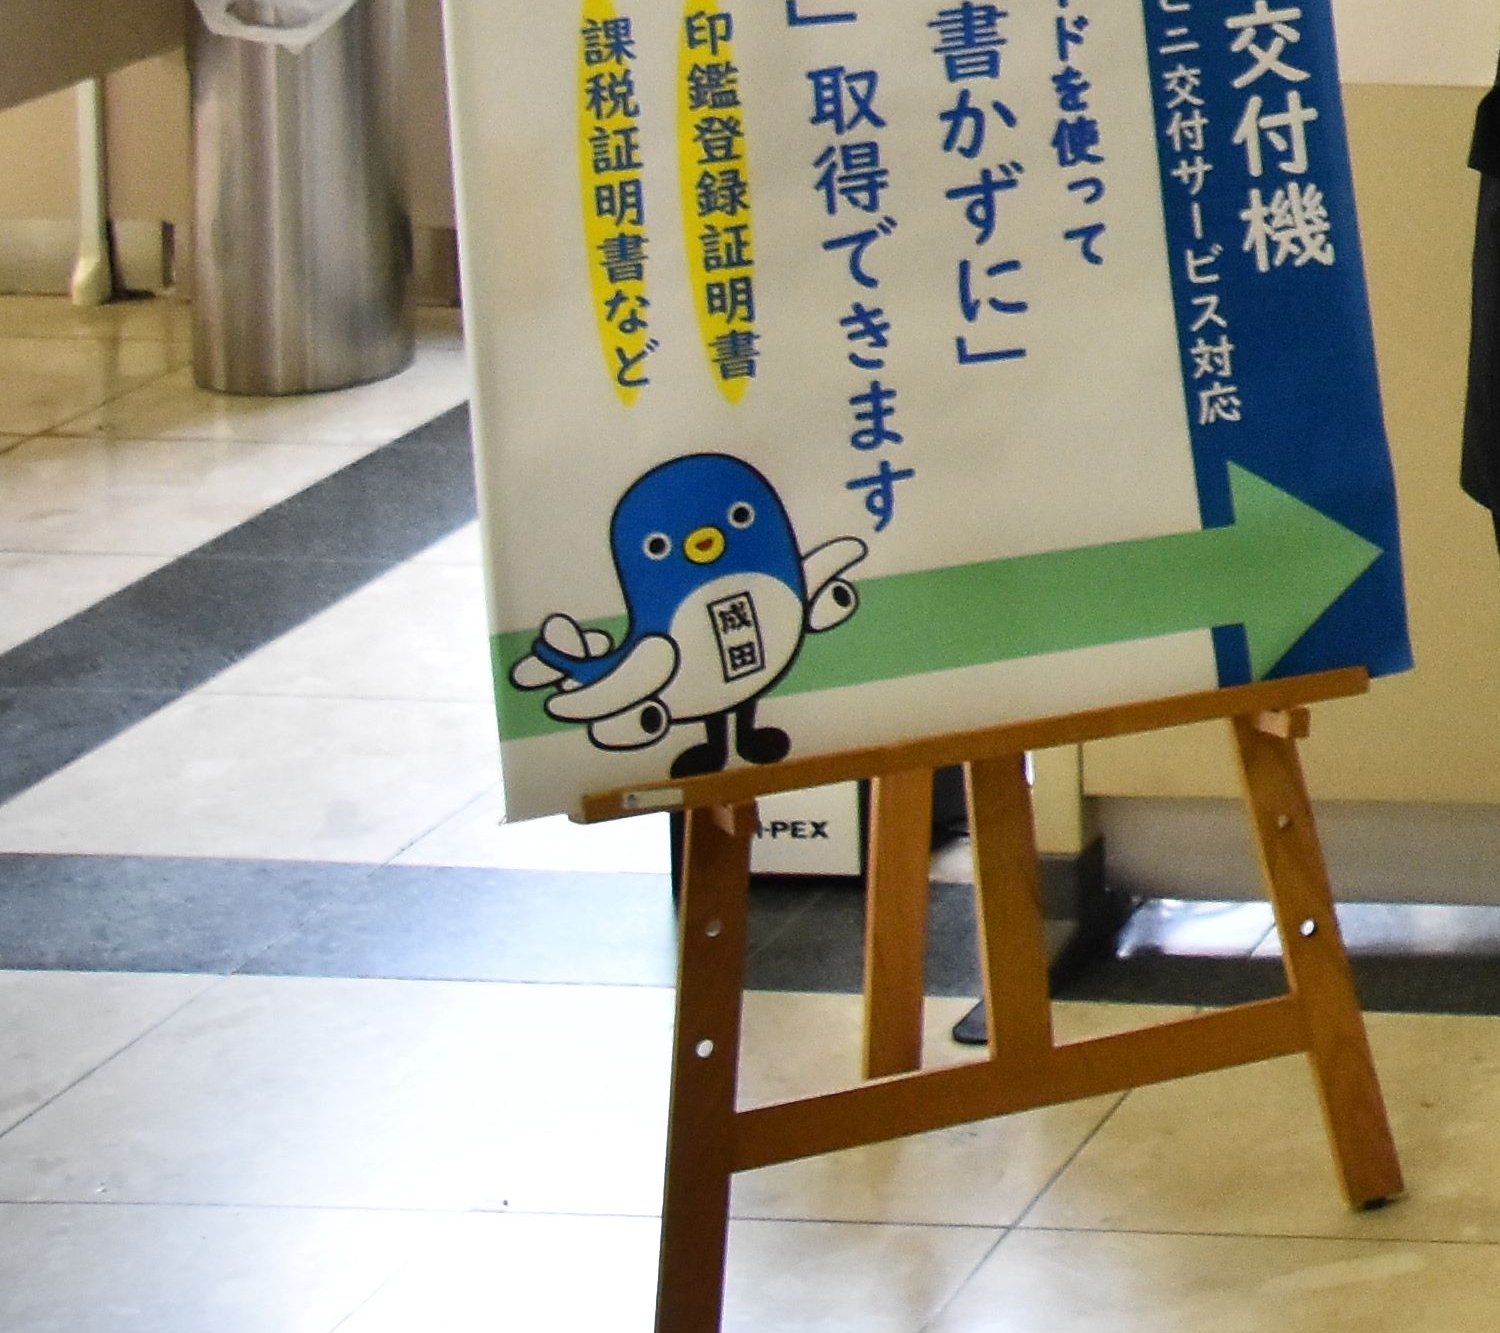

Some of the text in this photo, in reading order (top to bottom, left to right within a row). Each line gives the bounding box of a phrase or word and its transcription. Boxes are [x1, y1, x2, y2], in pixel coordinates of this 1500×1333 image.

[580, 15, 659, 392] 課税証明書など
[683, 9, 762, 381] 印鑑登録証明書
[718, 600, 757, 672] 成田
